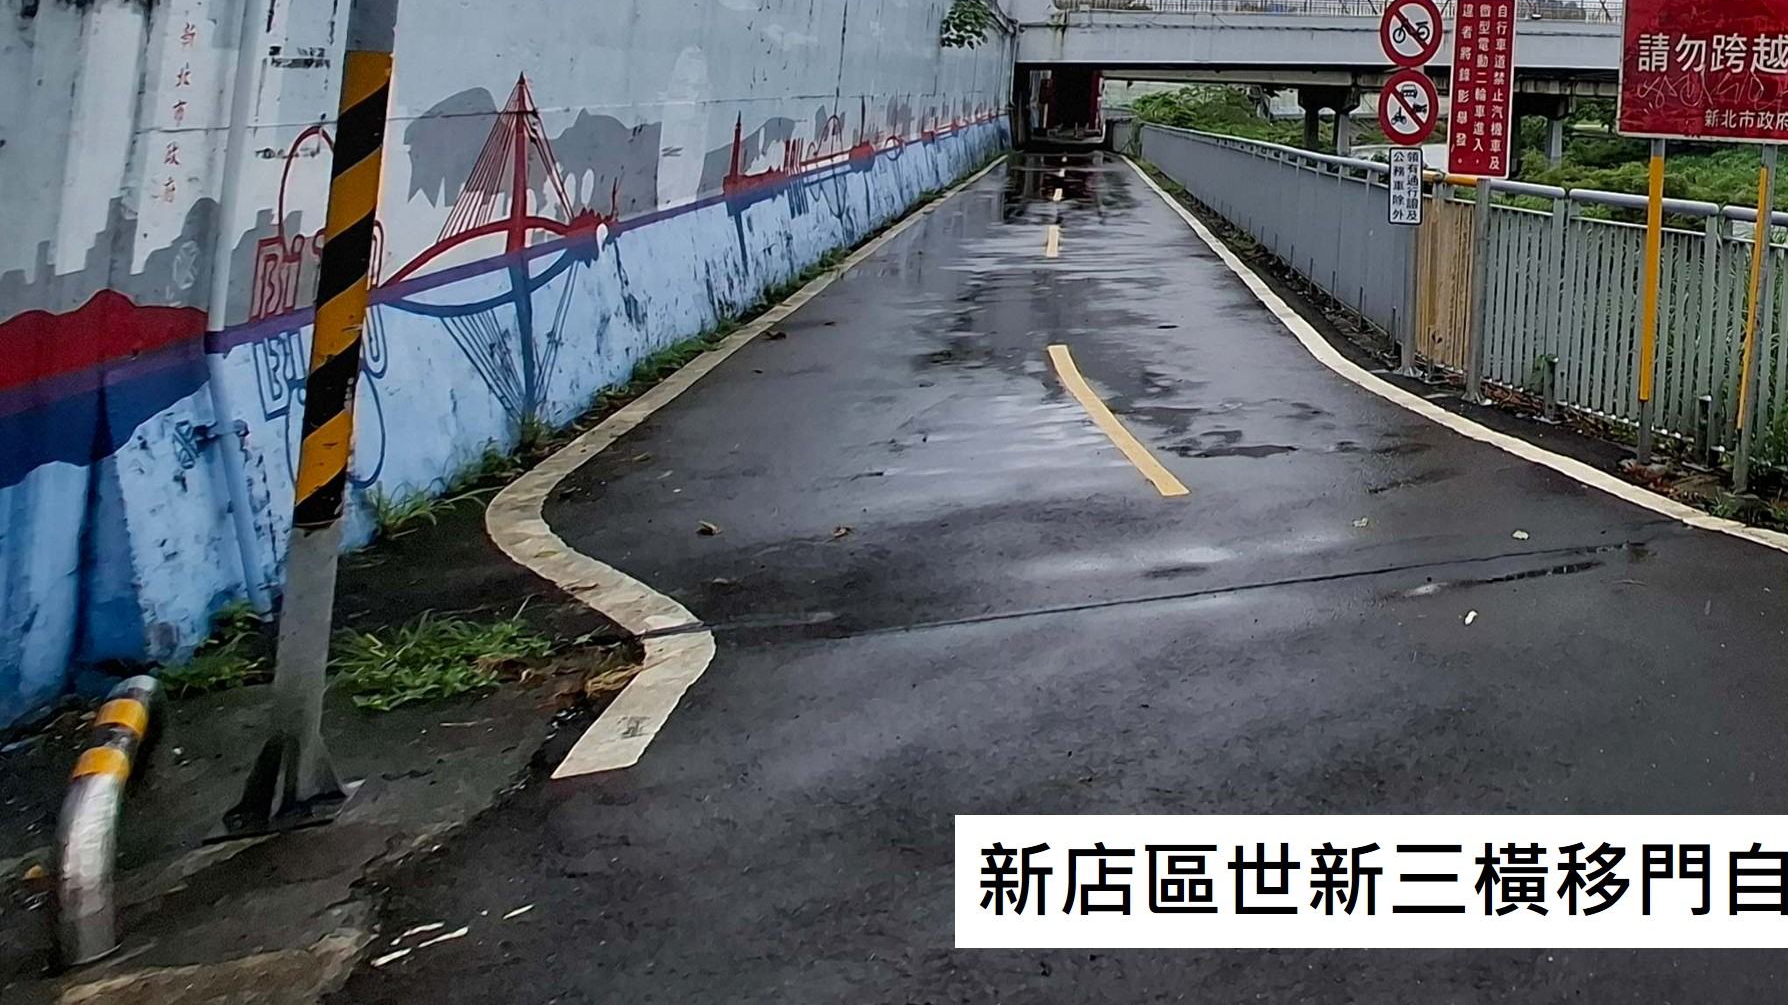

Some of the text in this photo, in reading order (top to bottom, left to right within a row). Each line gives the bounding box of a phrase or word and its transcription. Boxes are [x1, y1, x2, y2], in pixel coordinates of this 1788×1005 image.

[1488, 3, 1508, 171] 自行車道禁止汽機車及
[1392, 150, 1405, 220] 公務車除外
